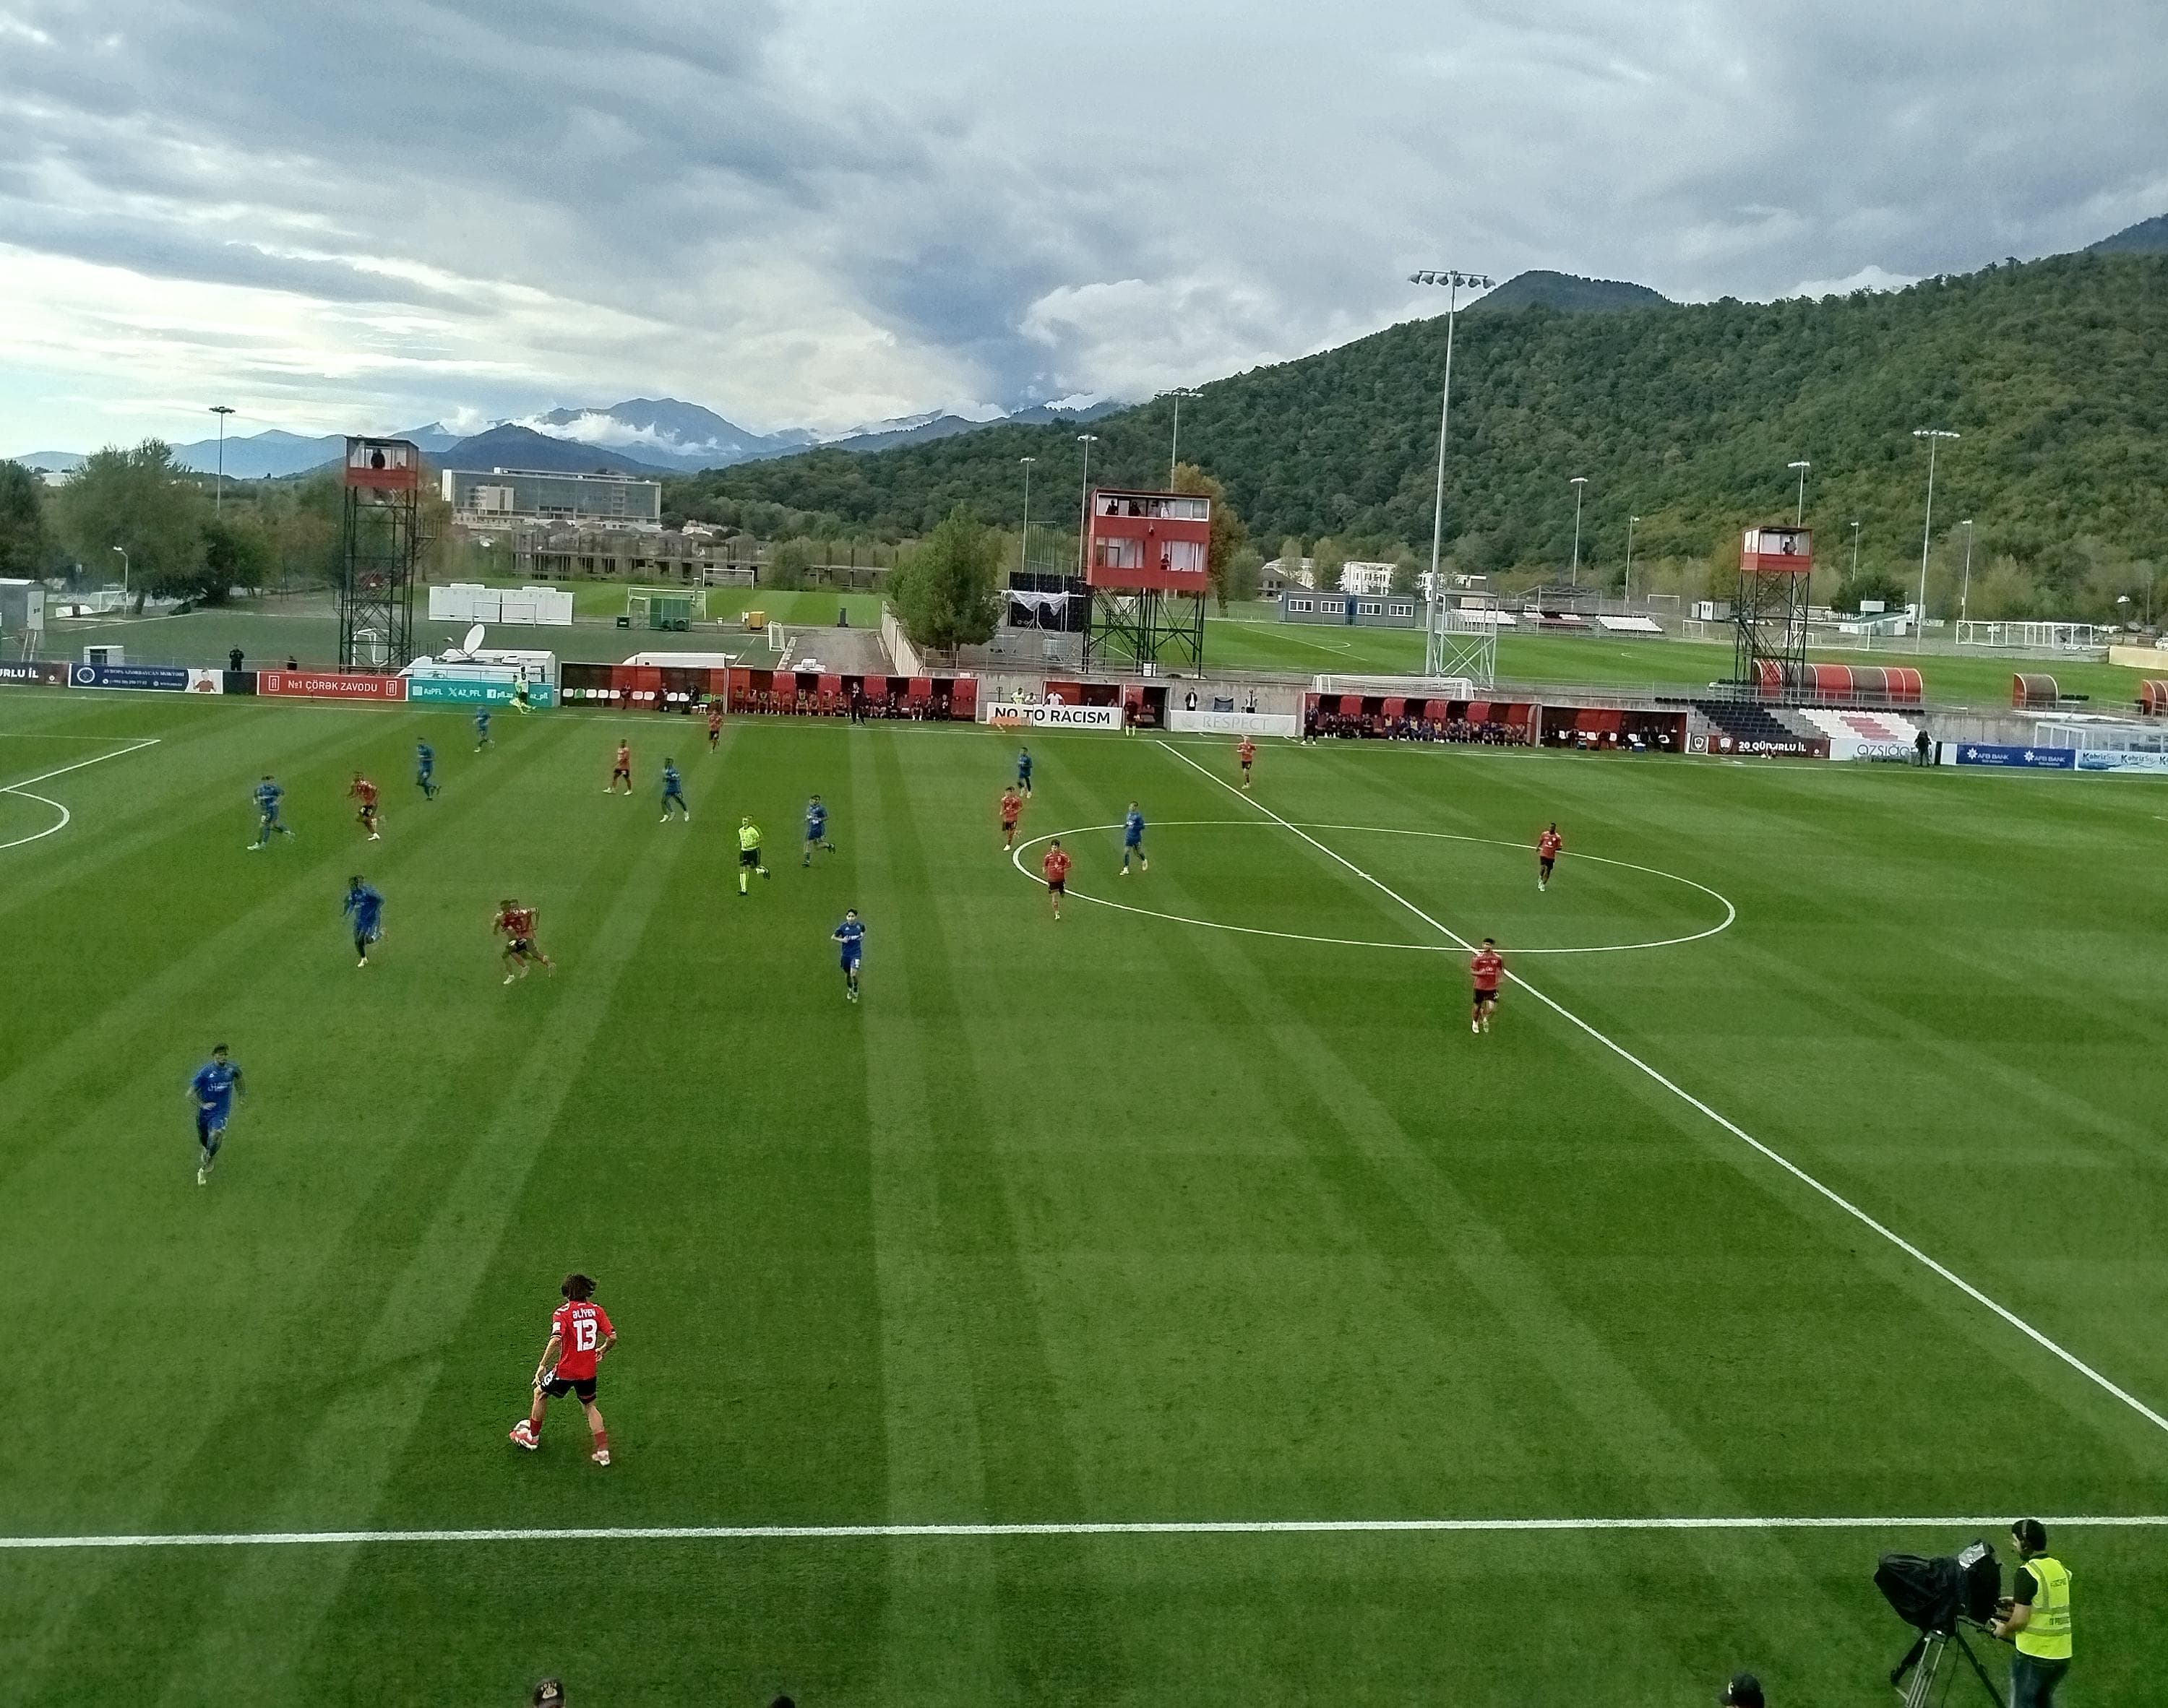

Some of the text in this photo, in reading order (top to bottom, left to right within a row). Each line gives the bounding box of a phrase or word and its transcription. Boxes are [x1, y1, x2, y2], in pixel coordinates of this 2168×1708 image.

[28, 667, 39, 678] İL
[306, 679, 339, 691] ÇÖRƏK
[340, 682, 377, 692] ZAVODU
[994, 707, 1110, 725] NO TO RACISM
[1203, 715, 1269, 730] RESPECT
[1738, 741, 1750, 750] 20
[1798, 741, 1807, 752] İL
[572, 1319, 598, 1352] 13
